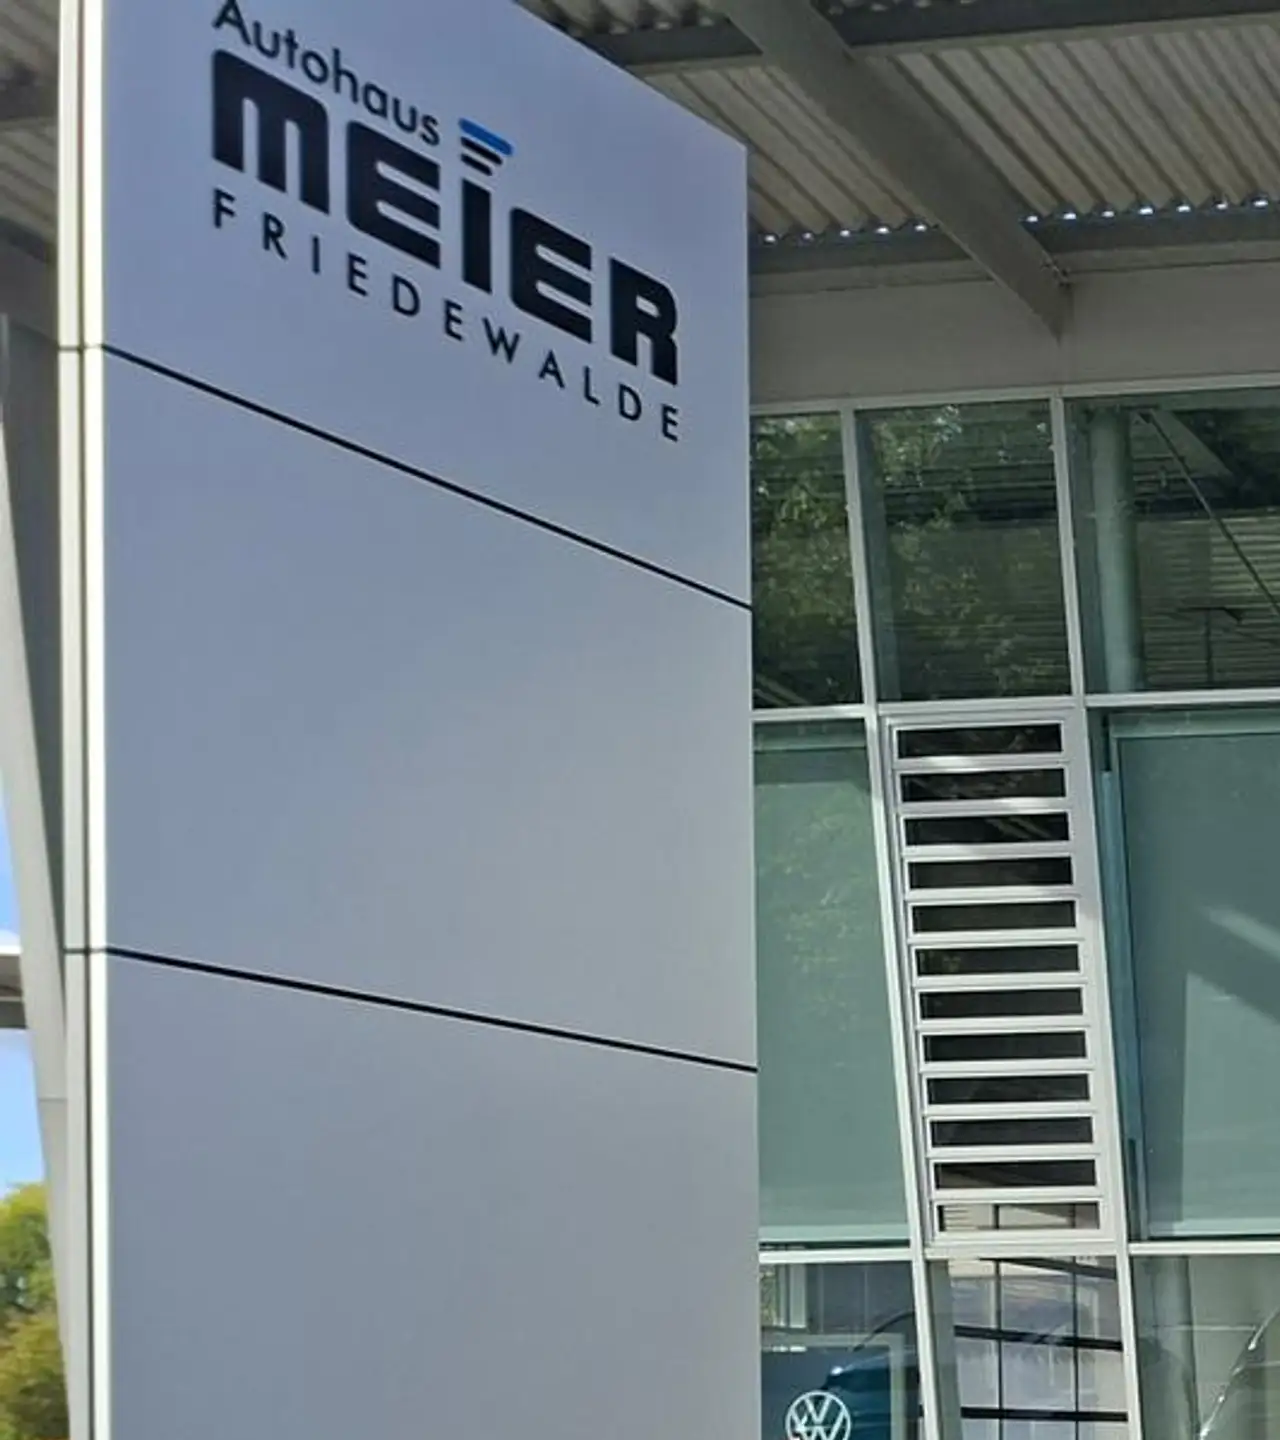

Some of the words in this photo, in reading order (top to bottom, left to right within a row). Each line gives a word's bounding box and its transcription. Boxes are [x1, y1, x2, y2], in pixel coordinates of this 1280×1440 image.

[212, 0, 440, 146] Autohaus
[212, 49, 678, 386] MEIER
[213, 189, 679, 442] FRIEDEWALDE
